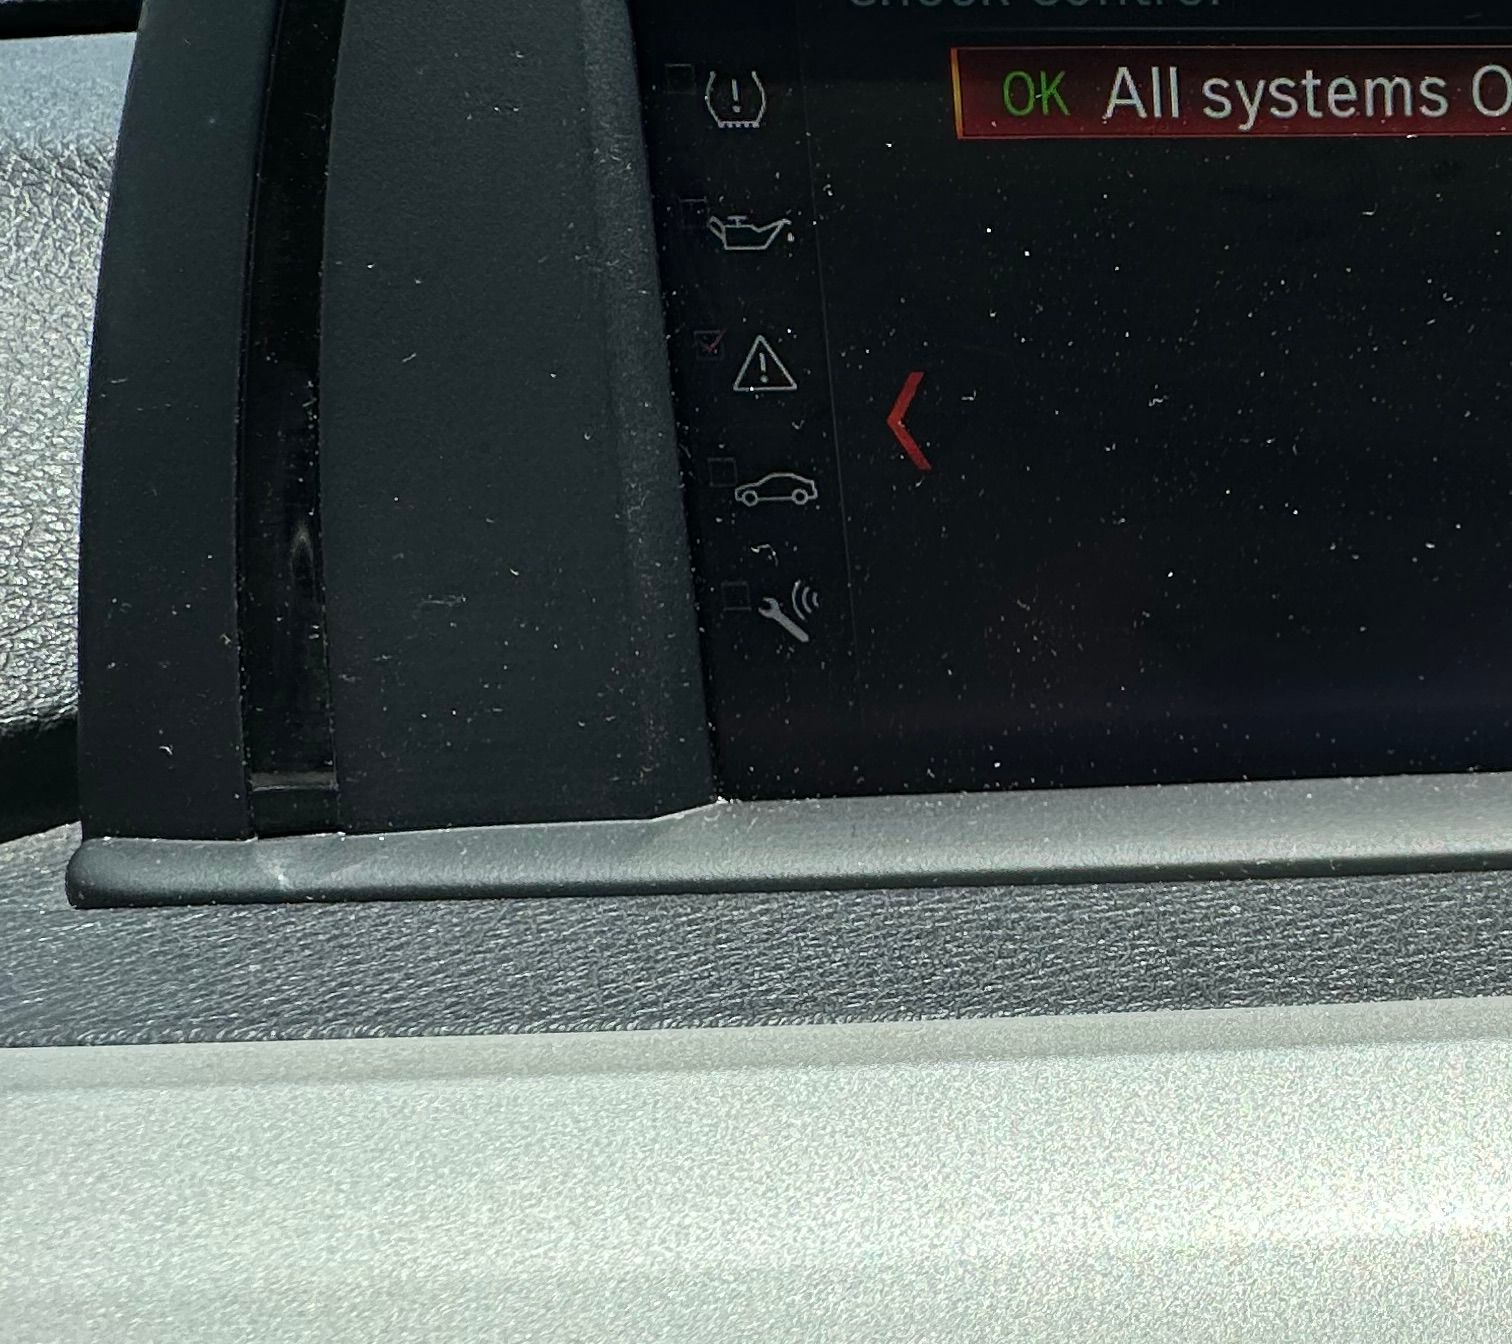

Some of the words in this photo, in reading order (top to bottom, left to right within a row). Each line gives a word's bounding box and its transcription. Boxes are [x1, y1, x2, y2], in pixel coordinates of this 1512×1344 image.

[1001, 69, 1071, 117] OK
[1103, 65, 1182, 119] All
[1201, 69, 1449, 132] systems
